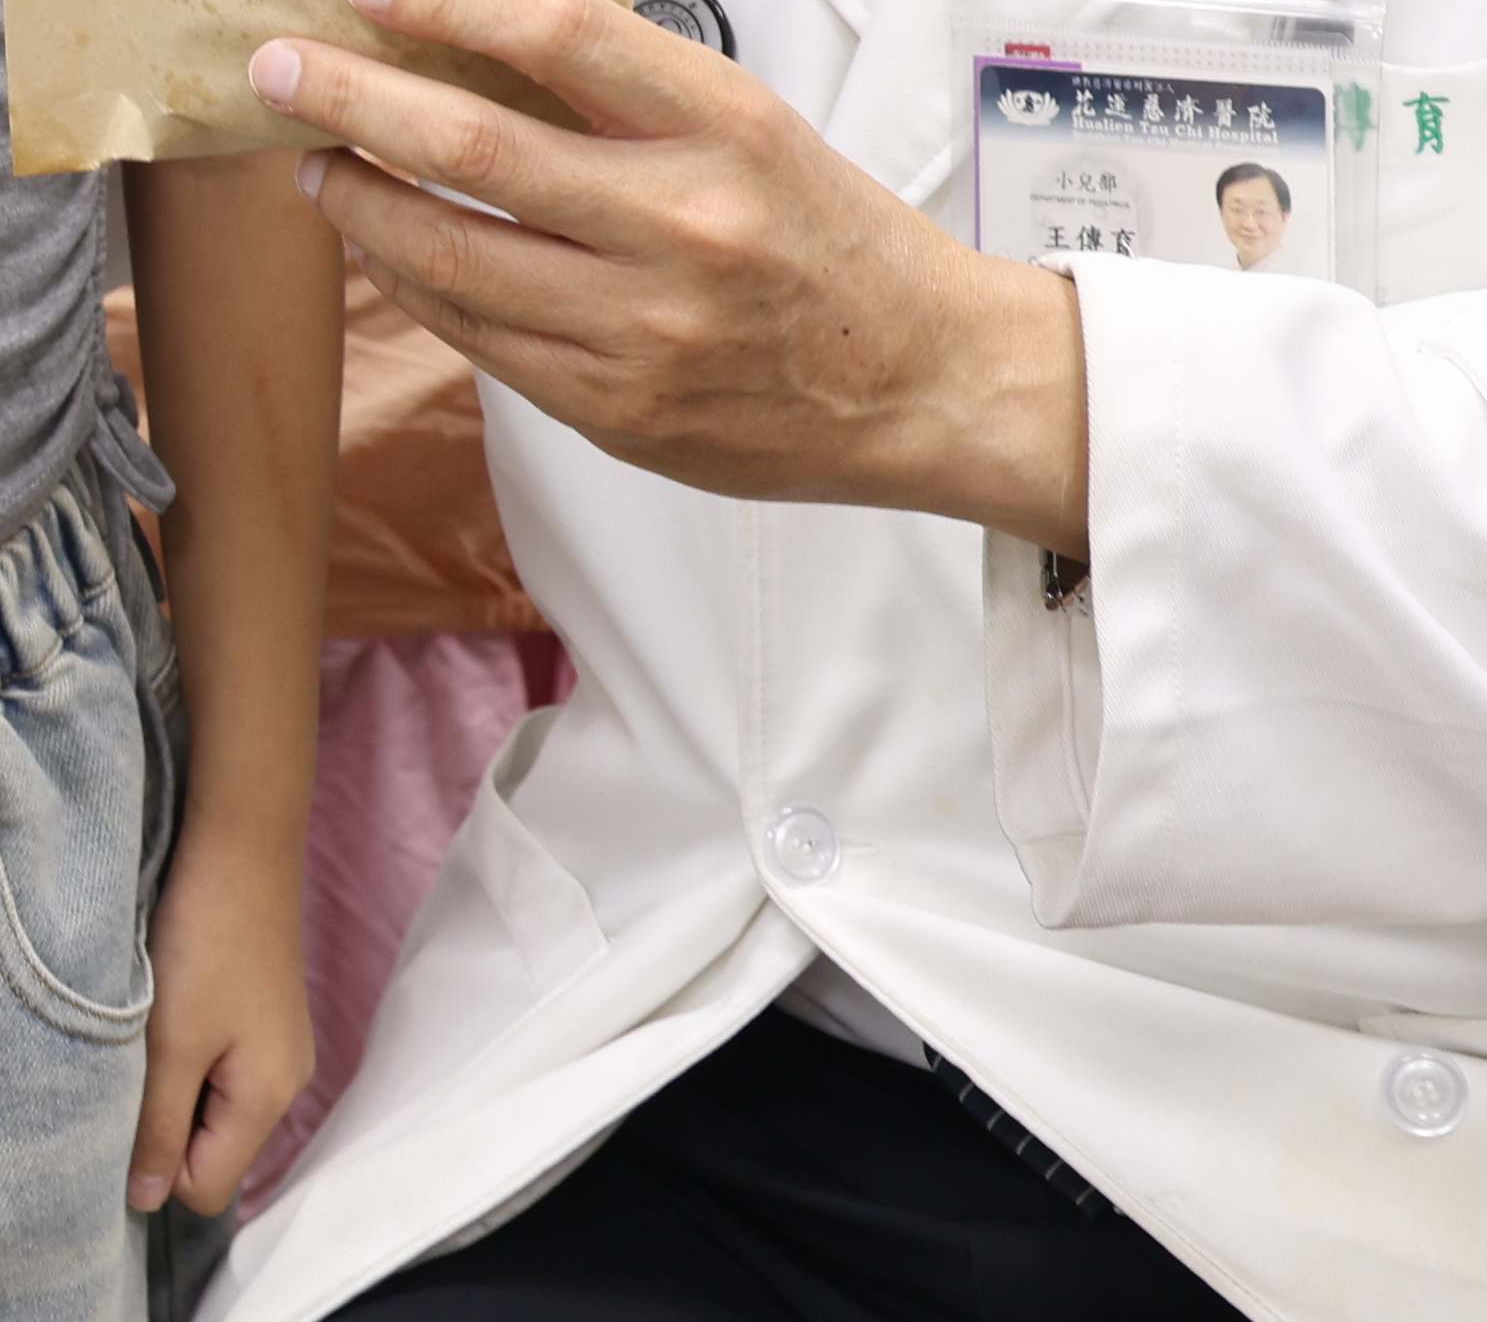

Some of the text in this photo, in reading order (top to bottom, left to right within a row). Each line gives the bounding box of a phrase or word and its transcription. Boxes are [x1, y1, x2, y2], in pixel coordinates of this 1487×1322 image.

[1073, 89, 1276, 129] 花蓮慈濟醫院
[1072, 116, 1135, 134] Hualien
[1140, 120, 1169, 137] Tzu
[1175, 123, 1203, 140] Chi
[1208, 125, 1279, 145] Hospital
